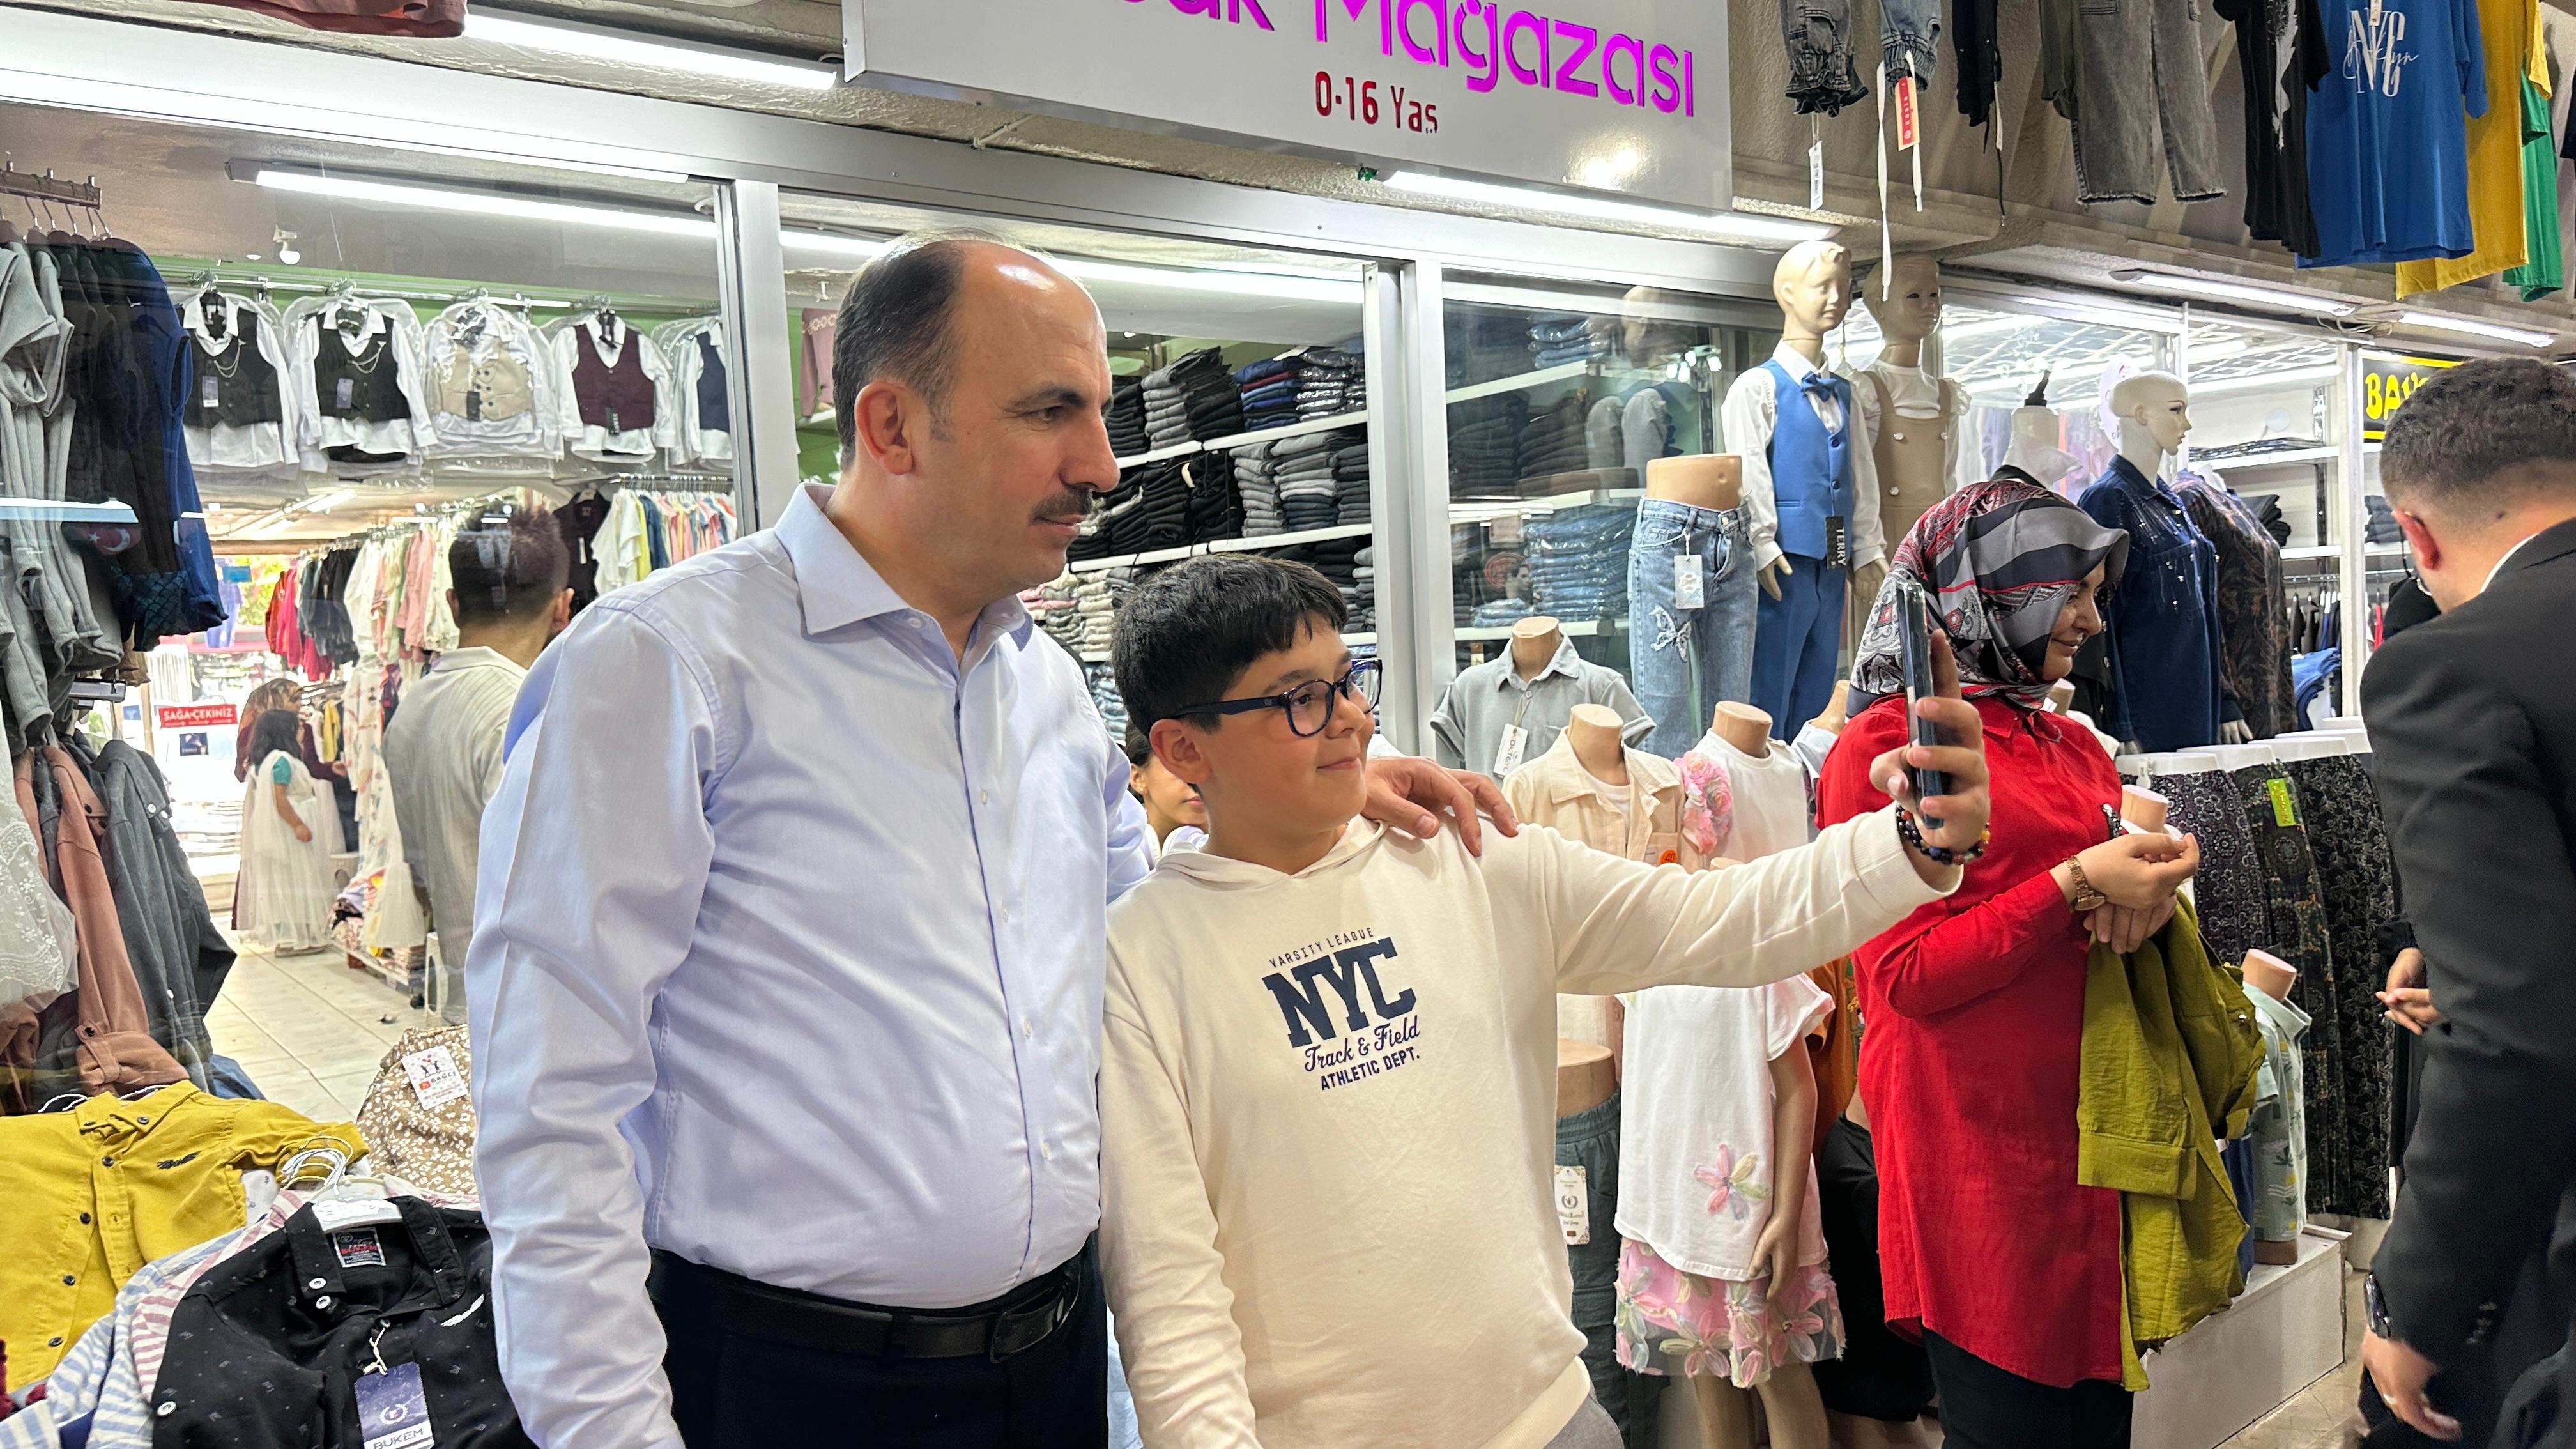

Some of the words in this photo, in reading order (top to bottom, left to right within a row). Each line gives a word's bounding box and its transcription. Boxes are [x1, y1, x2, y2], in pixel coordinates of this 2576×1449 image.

[1315, 71, 1379, 125] 0-16
[1836, 526, 1847, 566] TERRY
[1269, 941, 1322, 968] VARSITY
[1326, 927, 1374, 948] LEAGUE
[1262, 937, 1416, 1048] NYC
[1305, 1038, 1354, 1072] Track
[1358, 1037, 1370, 1055] &
[1374, 1015, 1421, 1051] Field
[1321, 1060, 1380, 1091] ATHLETIC
[1383, 1046, 1420, 1071] DEPT.
[374, 1427, 424, 1449] BUKEM
